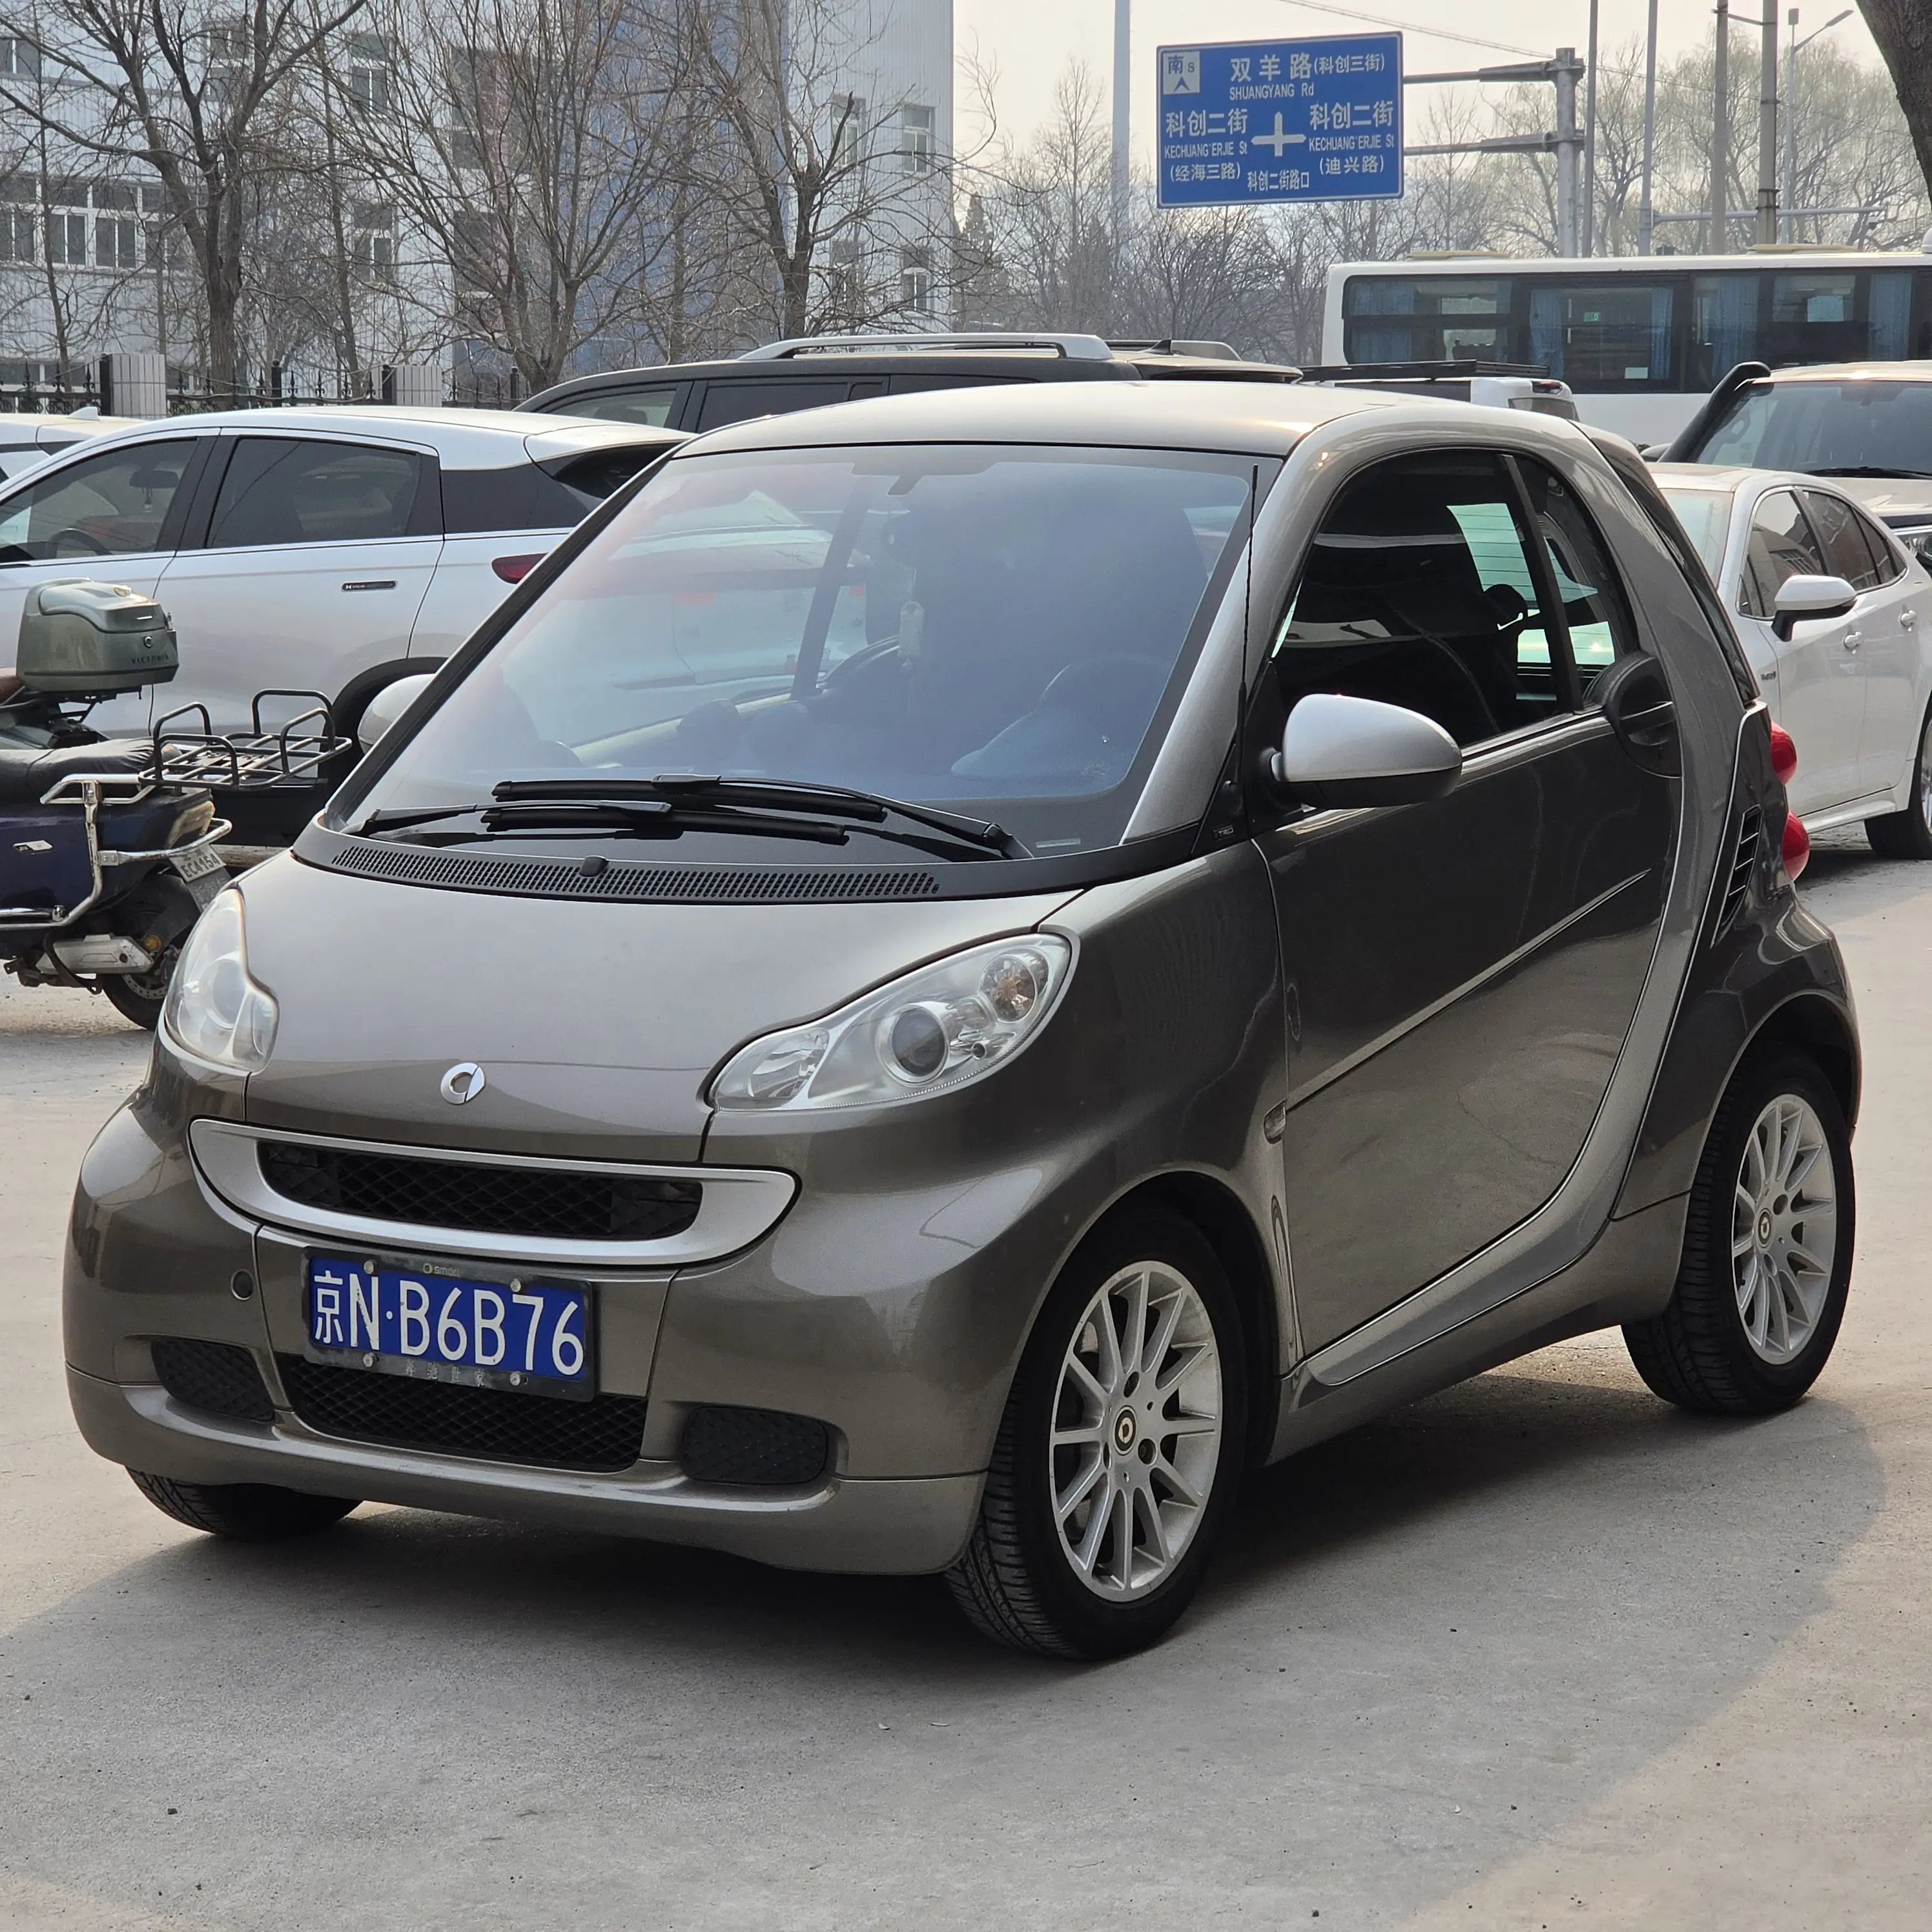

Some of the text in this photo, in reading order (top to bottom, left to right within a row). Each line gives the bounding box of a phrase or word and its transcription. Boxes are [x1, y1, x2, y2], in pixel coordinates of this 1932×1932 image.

[1167, 55, 1195, 74] 南 S
[1230, 53, 1384, 81] 双羊路 (科创三街)
[1229, 82, 1314, 101] SHUANGYANG Rd
[1166, 108, 1248, 138] 科创二街
[1310, 100, 1393, 130] 科创二街
[1239, 141, 1248, 155] St
[1386, 134, 1394, 148] St
[1171, 162, 1240, 182] (经海三路)
[1319, 155, 1384, 175] (迪兴路)
[1247, 169, 1310, 192] 科创二街路口
[434, 1266, 460, 1277] smart
[314, 1270, 584, 1375] 京N·B6B76
